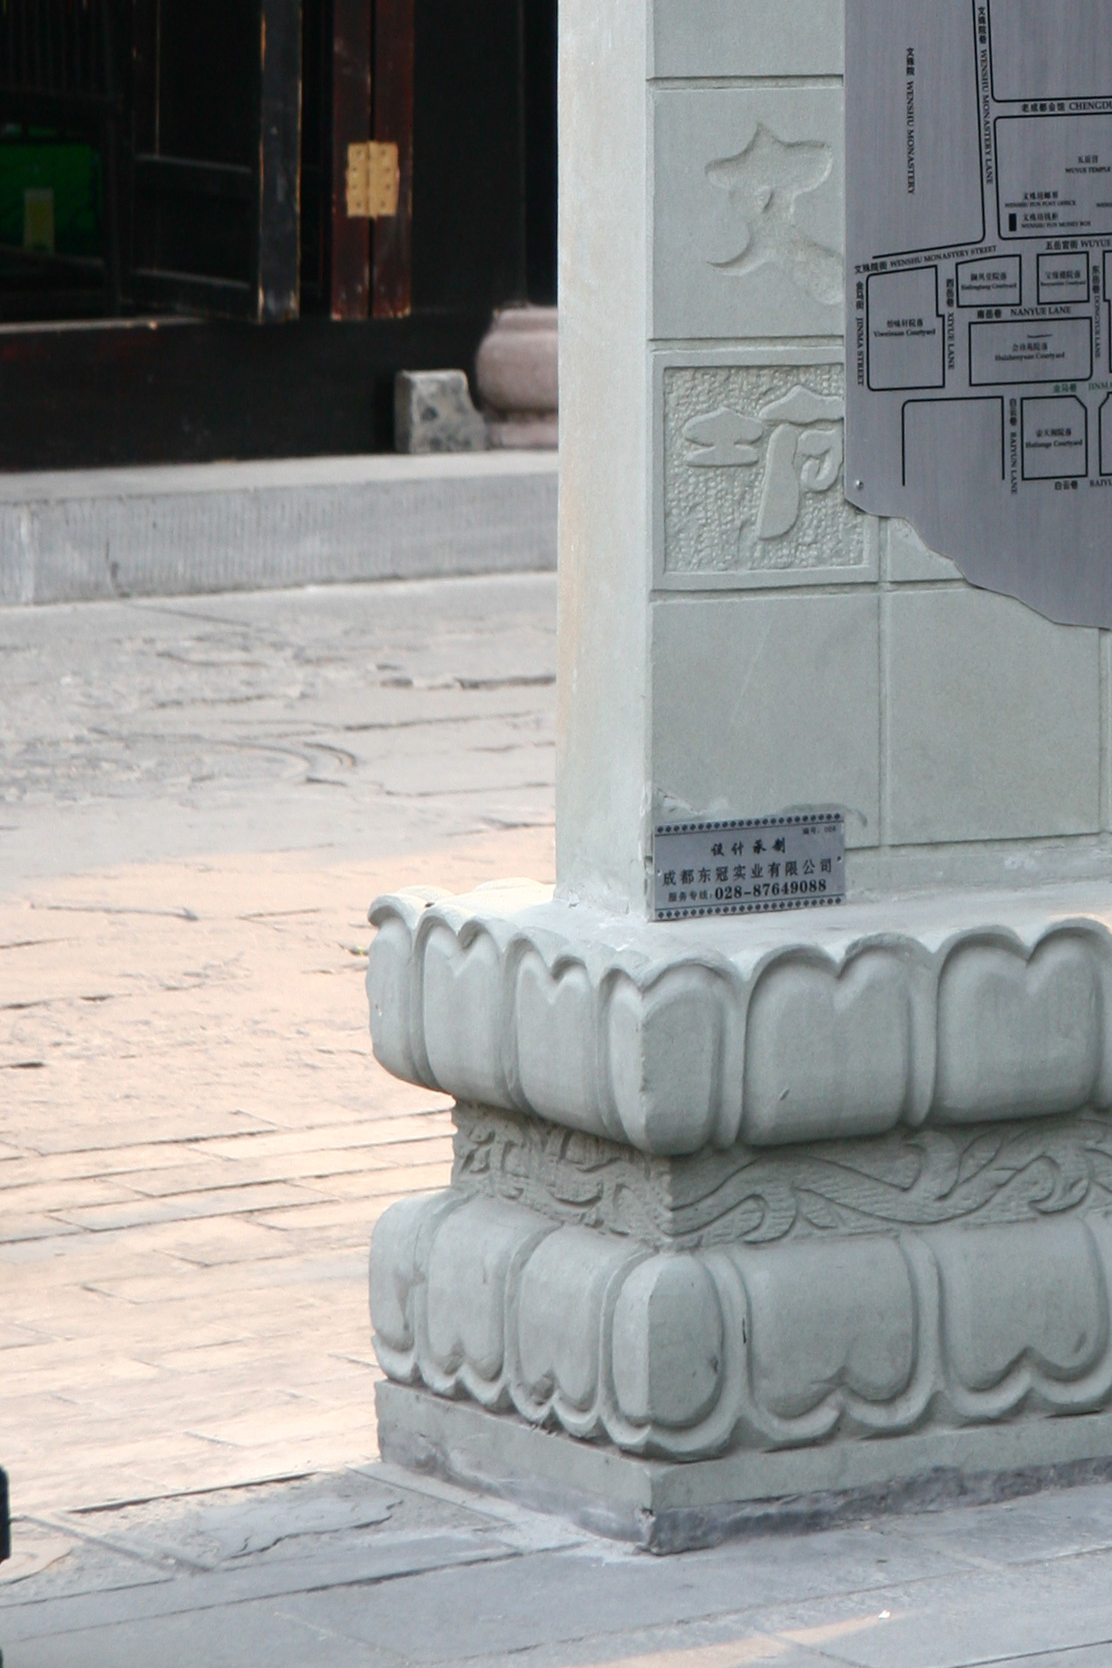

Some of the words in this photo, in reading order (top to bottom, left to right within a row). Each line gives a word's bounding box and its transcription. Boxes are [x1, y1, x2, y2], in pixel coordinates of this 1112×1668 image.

[907, 80, 915, 127] WENSHU
[981, 95, 992, 156] MONASTERY
[907, 130, 916, 195] MONASTERY
[985, 158, 994, 184] LANE
[1081, 238, 1111, 247] WUYUE
[890, 256, 922, 267] WENSHU
[924, 250, 969, 262] MONASTERY
[970, 245, 997, 255] STREET
[1011, 307, 1047, 316] NANYUE
[1049, 306, 1071, 315] LANE
[662, 858, 833, 886] 成都东冠实业有限公司
[715, 879, 827, 901] 028-87649088
